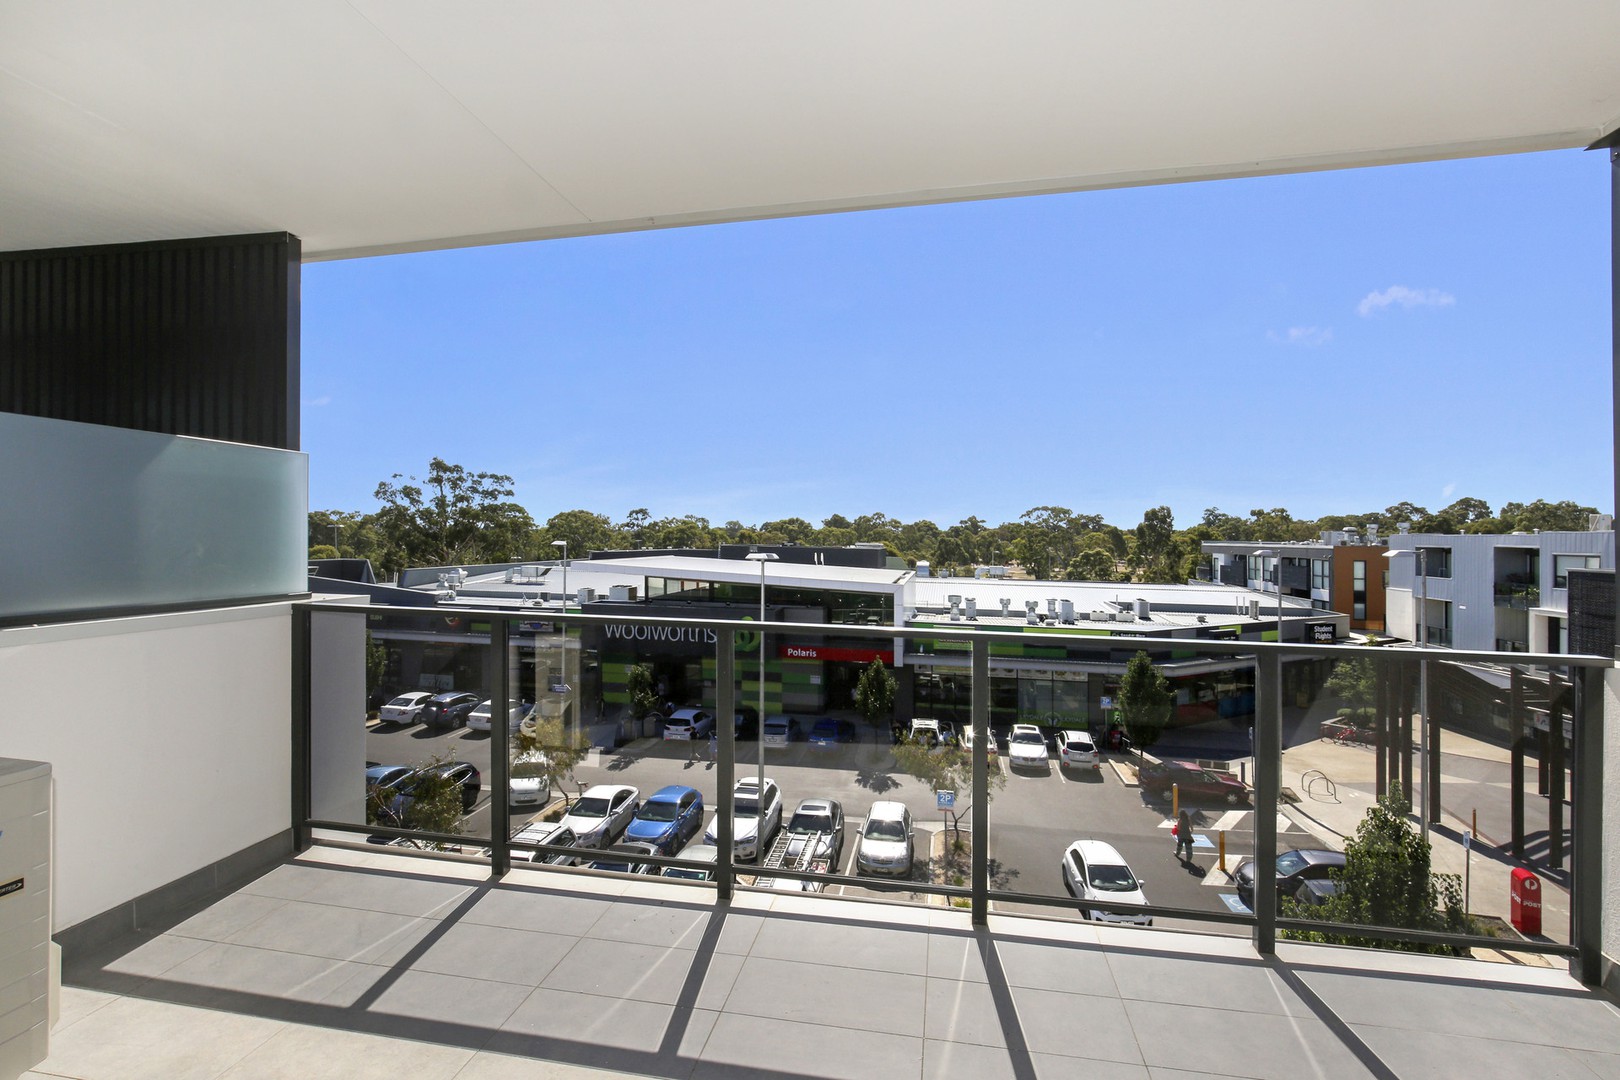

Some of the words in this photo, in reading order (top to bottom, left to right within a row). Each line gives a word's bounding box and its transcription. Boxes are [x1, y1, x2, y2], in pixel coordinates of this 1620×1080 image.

[787, 648, 817, 657] Polaris
[940, 794, 952, 802] 2P
[1523, 900, 1541, 908] POST
